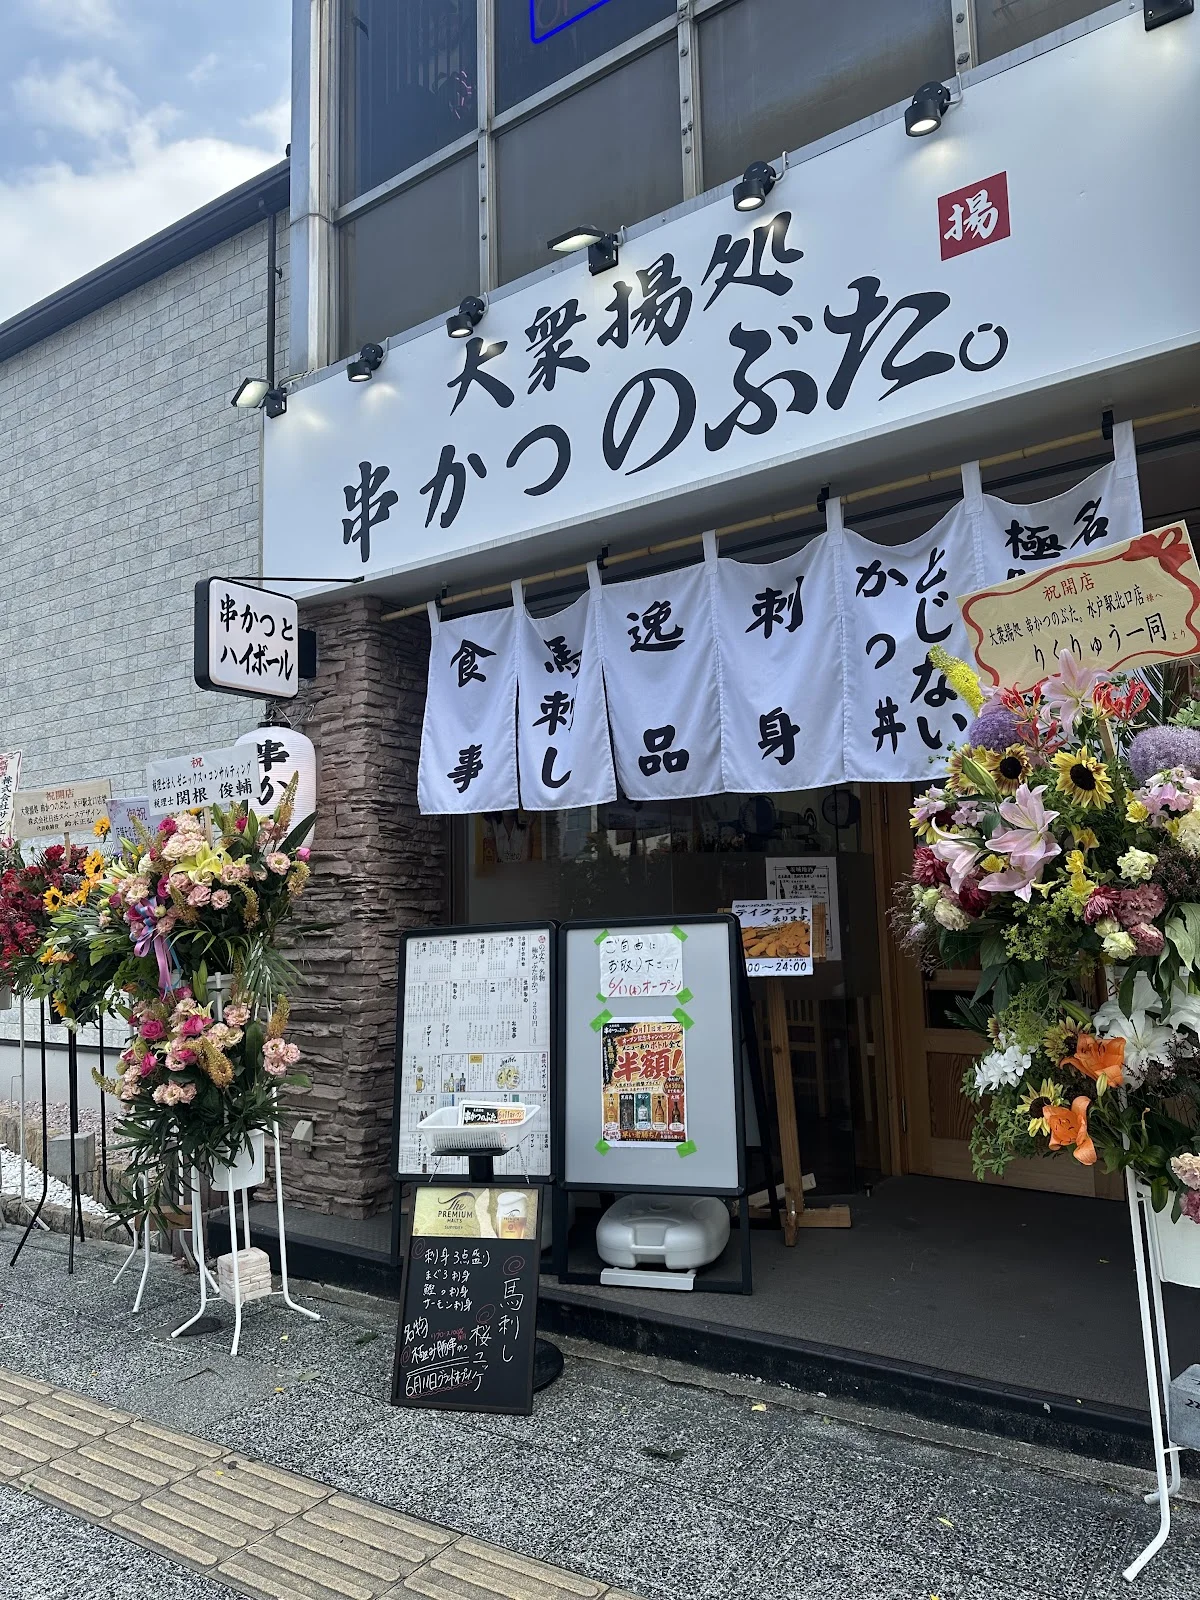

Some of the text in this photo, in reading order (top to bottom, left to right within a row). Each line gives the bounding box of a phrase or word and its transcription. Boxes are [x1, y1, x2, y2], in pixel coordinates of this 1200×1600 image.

[944, 188, 1001, 244] 揚
[446, 210, 805, 416] 大衆揚処
[342, 275, 1010, 563] 串かつのぶた。
[1043, 572, 1096, 602] 祝開店
[219, 593, 294, 642] 串かつと
[1032, 612, 1168, 672] りくりゅう一同
[220, 642, 294, 682] ハイボール
[744, 574, 804, 766] 刺身
[855, 559, 909, 755] かつ丼
[910, 546, 969, 751] とじない
[532, 635, 583, 788] 馬刺し
[626, 600, 691, 777] 逸品
[449, 638, 498, 793] 食事
[191, 757, 204, 769] 祝
[45, 788, 75, 801] 祝開店
[154, 777, 253, 809] 税理士 関根 俊輔
[735, 906, 809, 917] テイクアウト
[606, 938, 656, 954] ご自由に
[613, 1048, 683, 1083] 半額!
[437, 1210, 473, 1219] PREMIUM
[403, 1316, 429, 1346] 名物
[498, 1277, 525, 1363] 馬刺し
